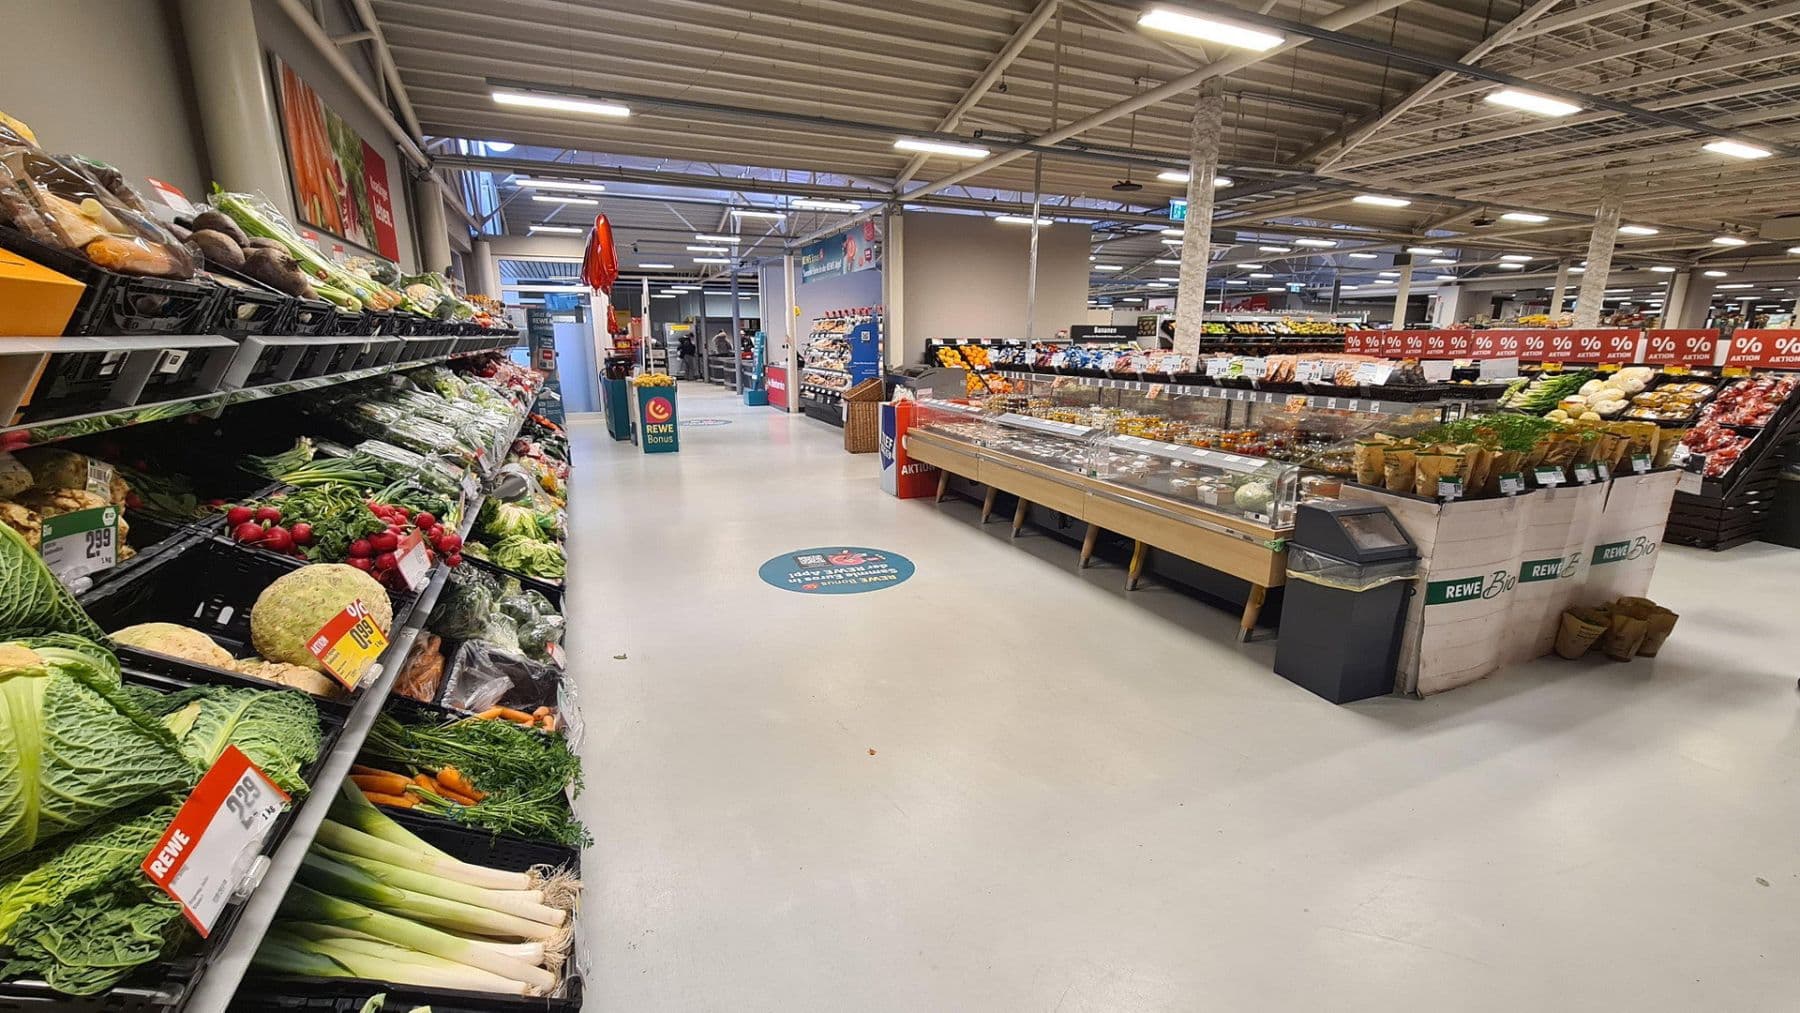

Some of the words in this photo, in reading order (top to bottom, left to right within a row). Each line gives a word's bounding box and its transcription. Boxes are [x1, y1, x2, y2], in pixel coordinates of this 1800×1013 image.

[1348, 336, 1360, 347] %
[1366, 336, 1379, 347] %
[1388, 336, 1401, 347] %
[1408, 336, 1422, 348] %
[1429, 336, 1444, 348] %
[1451, 336, 1467, 348] %
[1476, 336, 1492, 349] %
[1500, 336, 1517, 349] %
[1526, 336, 1544, 349] %
[1553, 336, 1572, 350] %
[1581, 336, 1601, 350] %
[1611, 336, 1632, 350] %
[1652, 336, 1675, 351] %
[1686, 336, 1711, 352] %
[1736, 337, 1762, 353] %
[646, 424, 674, 434] REWE
[647, 434, 673, 444] Bonus
[86, 528, 111, 559] 2.99
[1603, 545, 1629, 560] REWE
[1628, 536, 1656, 560] Bio
[788, 568, 821, 578] App!
[824, 565, 863, 575] REWE
[845, 568, 898, 580] Sammle
[805, 573, 843, 582] Euros
[821, 578, 857, 586] Bonus
[860, 574, 897, 583] REWE
[1445, 581, 1481, 599] REWE
[1482, 570, 1516, 599] Bio
[349, 619, 374, 650] 0.99
[226, 775, 262, 831] 2.29
[262, 813, 268, 821] 1
[150, 828, 191, 879] REWE
